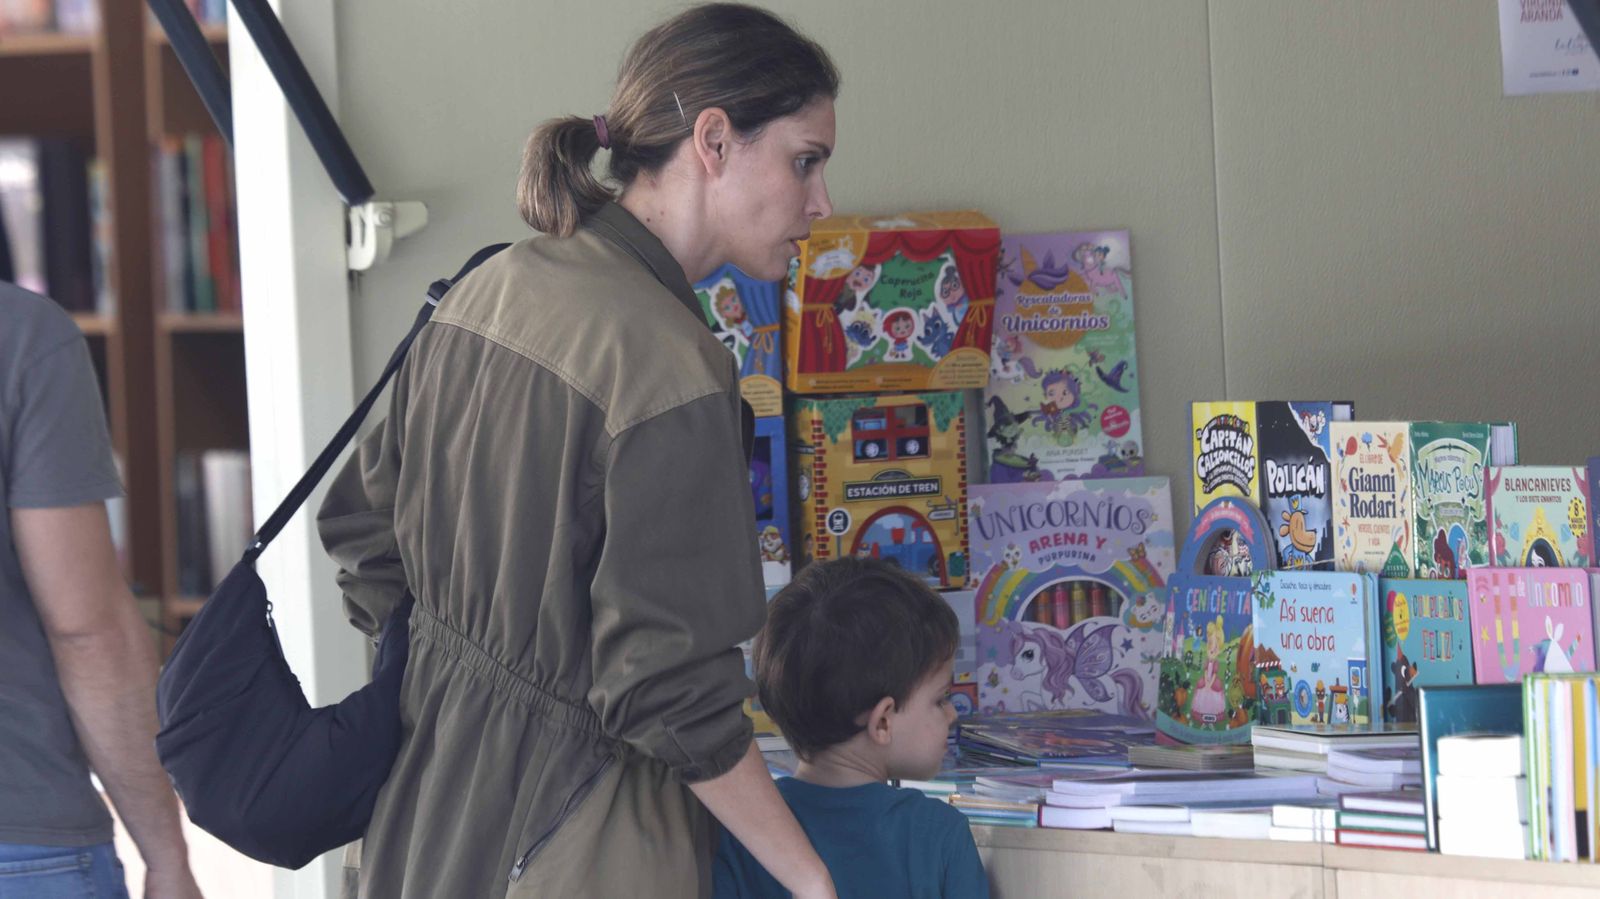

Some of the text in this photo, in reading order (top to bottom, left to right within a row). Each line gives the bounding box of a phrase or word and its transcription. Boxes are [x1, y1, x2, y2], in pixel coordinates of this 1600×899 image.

[1520, 8, 1563, 22] ARANDA
[900, 288, 922, 301] Roja
[1016, 293, 1091, 308] Rescatadoras
[1002, 312, 1109, 332] Unicornios
[1197, 449, 1255, 479] CALZONCILLOS
[1265, 456, 1325, 496] POLICÁN
[847, 482, 939, 498] ESTACIÓN DE TREN
[1348, 466, 1396, 493] Gianni
[1504, 477, 1572, 492] BLANCANIEVES
[1349, 493, 1397, 519] Rodari
[1573, 502, 1579, 517] 8
[976, 496, 1150, 541] UNICORNIOS
[1028, 532, 1107, 554] ARENA Y
[1280, 598, 1335, 624] Así suena
[1412, 591, 1464, 621] CUMPLEAÑOS
[1280, 626, 1336, 652] una obra
